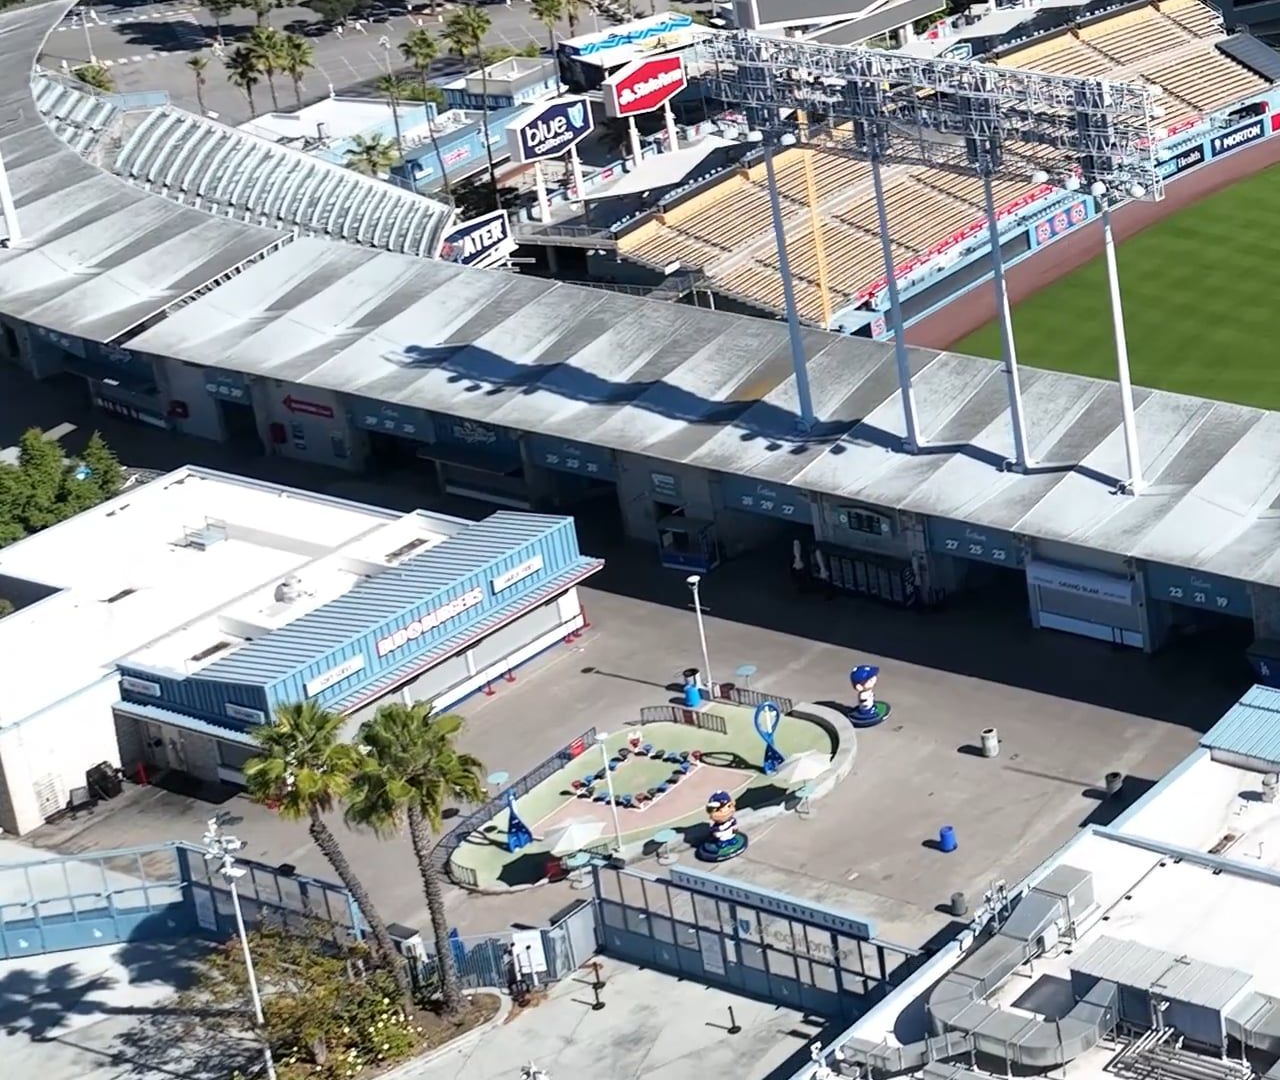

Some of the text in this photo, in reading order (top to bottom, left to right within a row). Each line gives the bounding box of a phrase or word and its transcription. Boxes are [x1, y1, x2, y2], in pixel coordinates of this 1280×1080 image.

[524, 115, 568, 147] blue
[1222, 124, 1262, 149] MORTON
[1178, 151, 1202, 169] Health
[461, 217, 505, 258] ATER
[945, 539, 960, 550] 27
[968, 544, 984, 555] 25
[1168, 586, 1229, 608] 23 21 19
